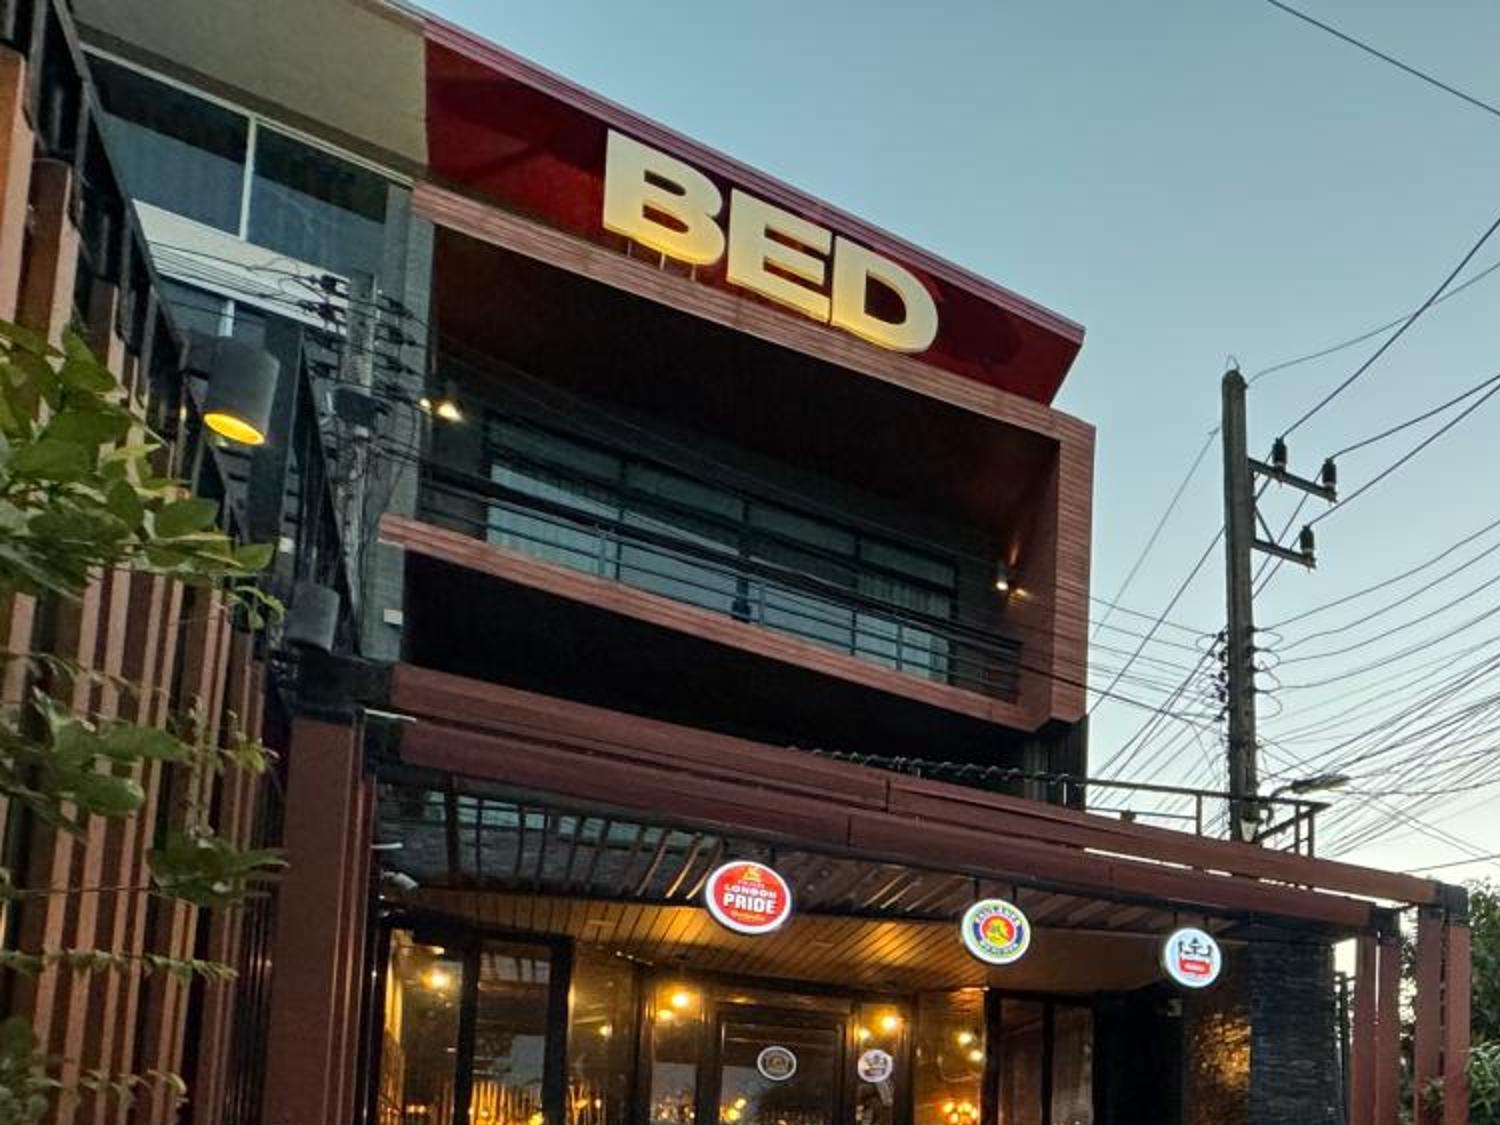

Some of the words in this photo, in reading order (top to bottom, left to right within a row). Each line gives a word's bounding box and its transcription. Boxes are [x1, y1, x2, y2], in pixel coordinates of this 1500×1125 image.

[603, 129, 939, 353] BED
[724, 883, 777, 899] LONDON
[723, 893, 777, 914] PRIDE
